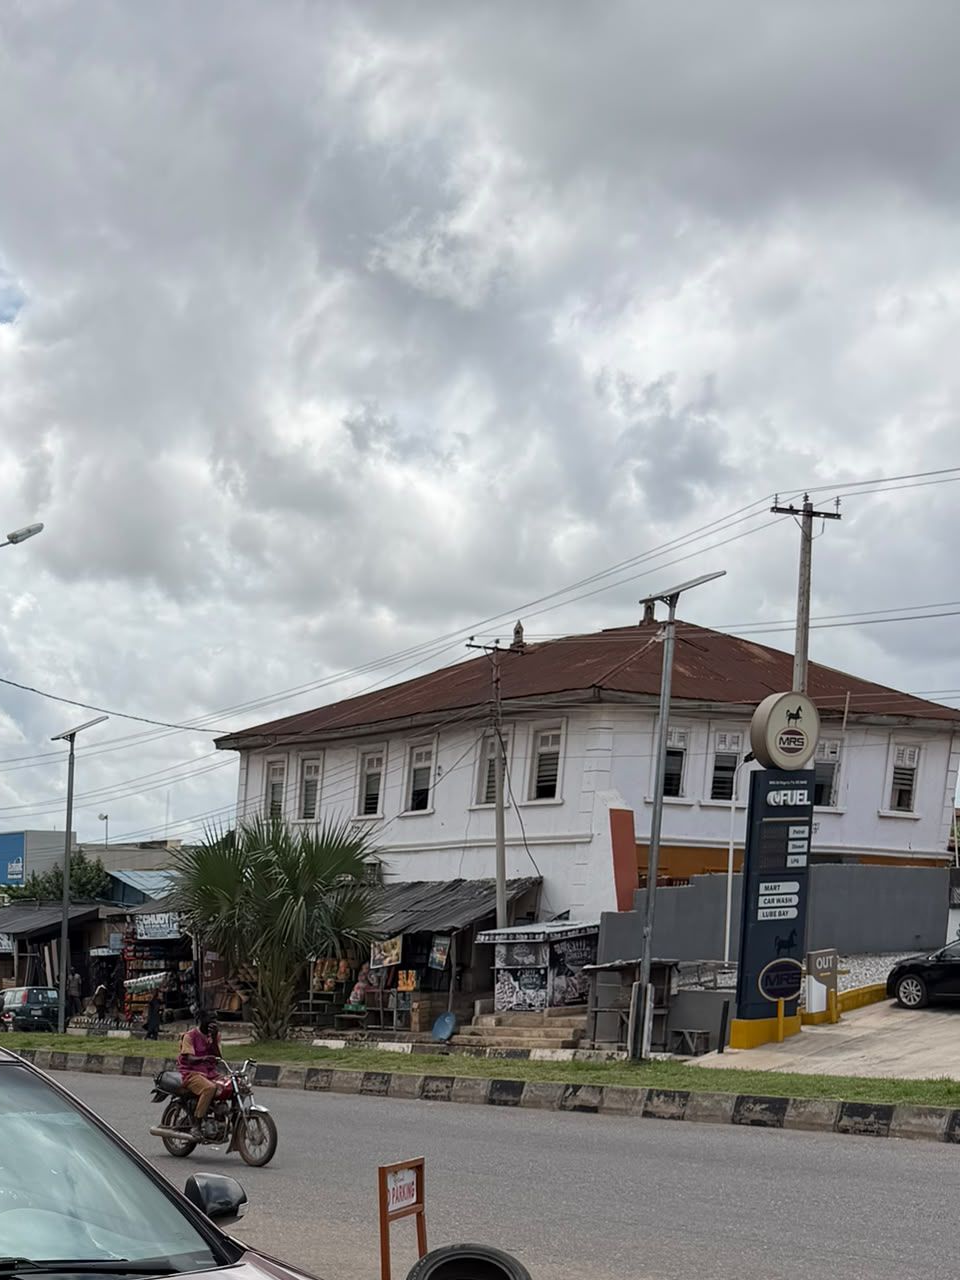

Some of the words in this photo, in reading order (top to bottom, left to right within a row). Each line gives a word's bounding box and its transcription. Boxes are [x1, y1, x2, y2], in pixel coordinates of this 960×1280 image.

[779, 736, 805, 747] MRS
[780, 790, 811, 806] FUEL
[763, 897, 776, 905] CAR
[762, 910, 777, 918] LUBE
[816, 956, 834, 969] OUT
